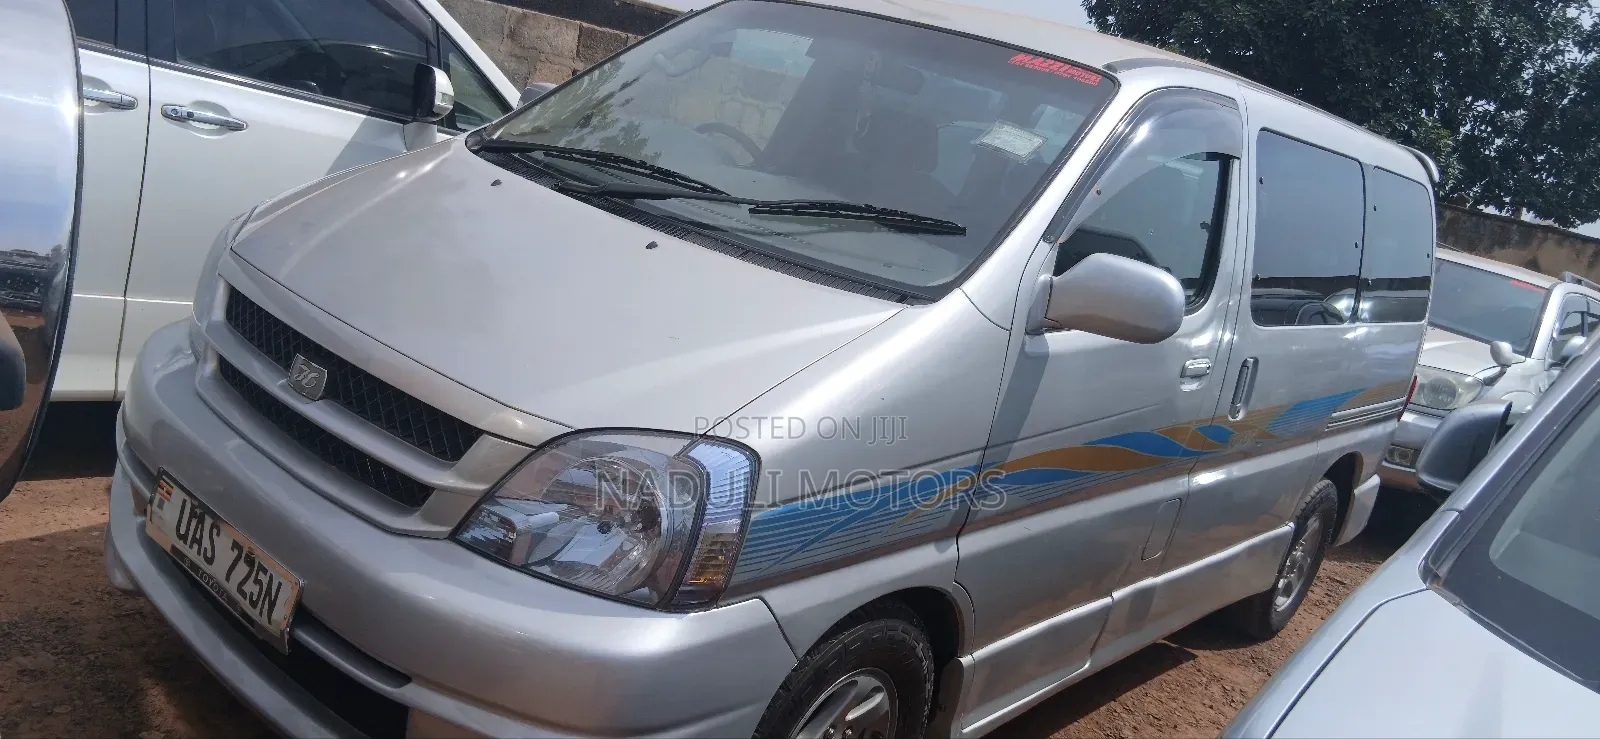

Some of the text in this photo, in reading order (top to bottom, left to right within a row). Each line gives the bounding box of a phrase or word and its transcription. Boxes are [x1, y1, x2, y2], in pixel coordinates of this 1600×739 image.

[175, 497, 283, 626] UAS 725N
[198, 568, 228, 601] TOYOTA
